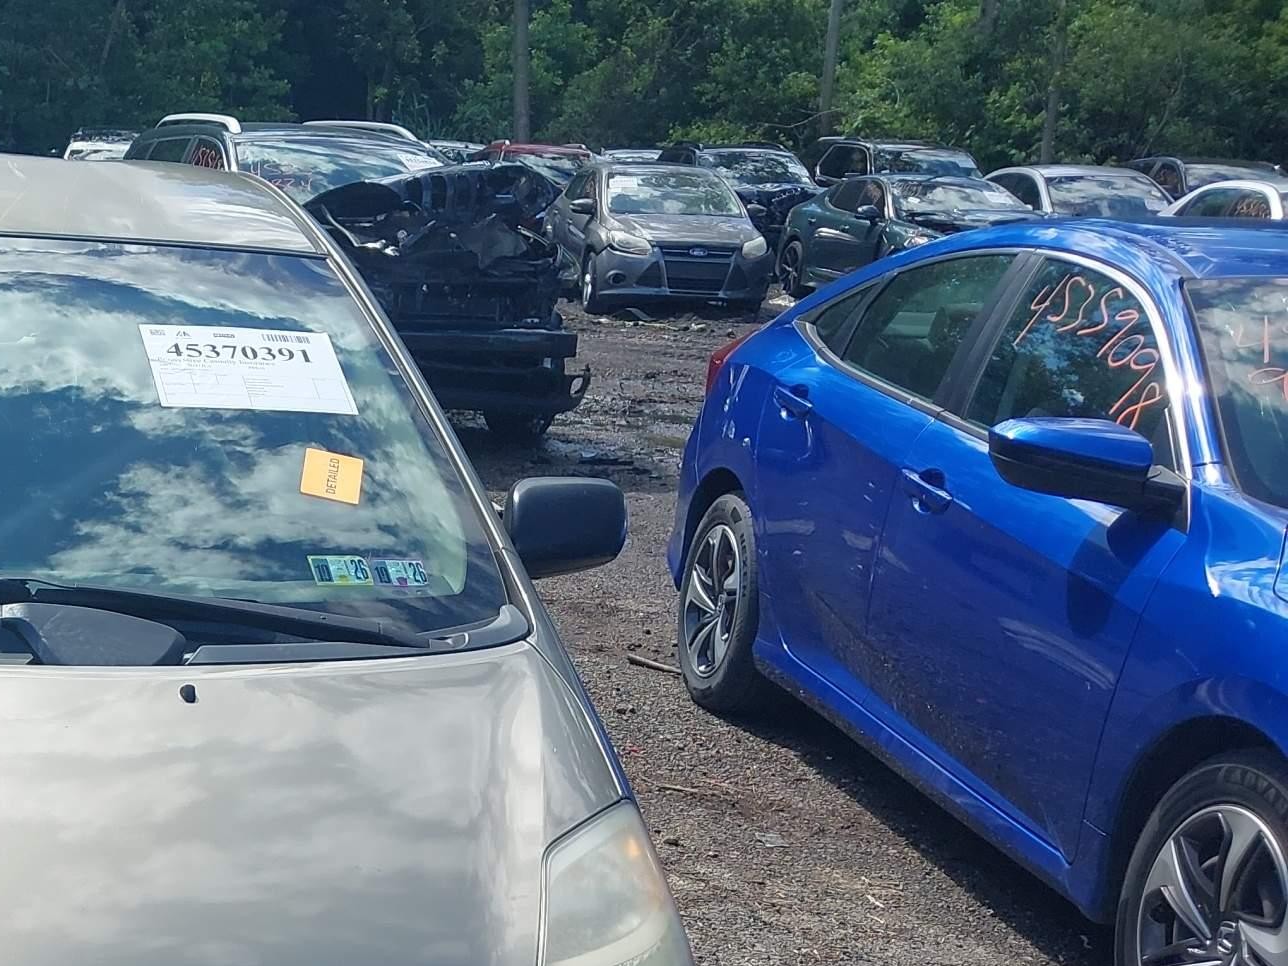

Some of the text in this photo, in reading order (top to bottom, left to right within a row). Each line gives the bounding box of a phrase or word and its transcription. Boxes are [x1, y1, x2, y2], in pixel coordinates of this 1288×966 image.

[166, 341, 313, 364] 45370391
[324, 457, 341, 496] DETAILED
[314, 563, 333, 583] 10
[349, 558, 370, 581] 26
[373, 565, 393, 585] 10
[408, 561, 429, 584] 26
